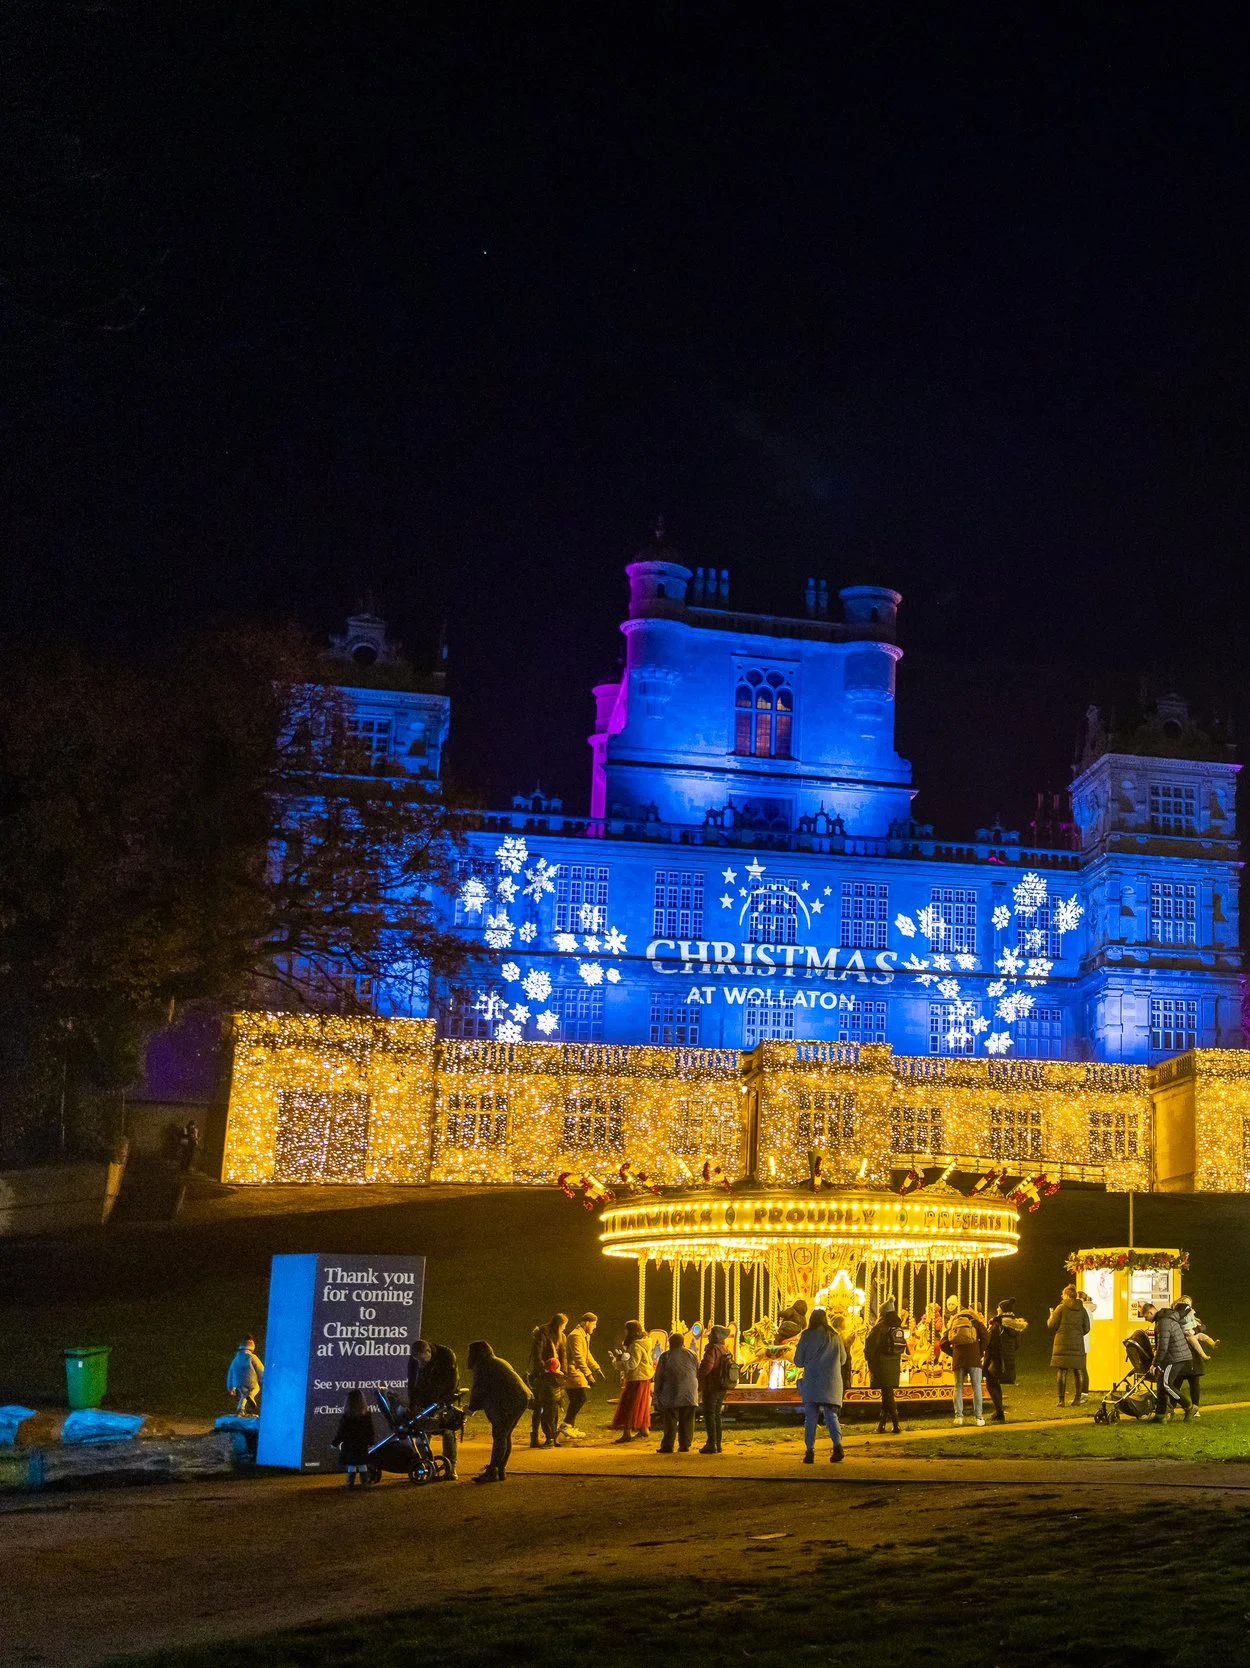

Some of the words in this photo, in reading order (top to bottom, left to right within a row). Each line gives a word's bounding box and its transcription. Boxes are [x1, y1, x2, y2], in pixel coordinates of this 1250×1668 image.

[646, 939, 898, 985] CHRISTMAS
[686, 986, 717, 1005] AT
[723, 986, 856, 1012] WOLLATON
[753, 1207, 876, 1226] PROUDLY
[923, 1210, 1001, 1231] PRESENTS
[324, 1268, 379, 1284] Thank
[383, 1272, 415, 1287] you
[322, 1286, 349, 1301] for
[352, 1288, 413, 1306] coming
[359, 1306, 376, 1320] to
[323, 1322, 408, 1339] Christmas
[316, 1343, 334, 1356] at
[338, 1340, 411, 1357] Wollaton
[313, 1379, 332, 1390] See
[335, 1380, 355, 1391] you
[358, 1379, 381, 1389] next
